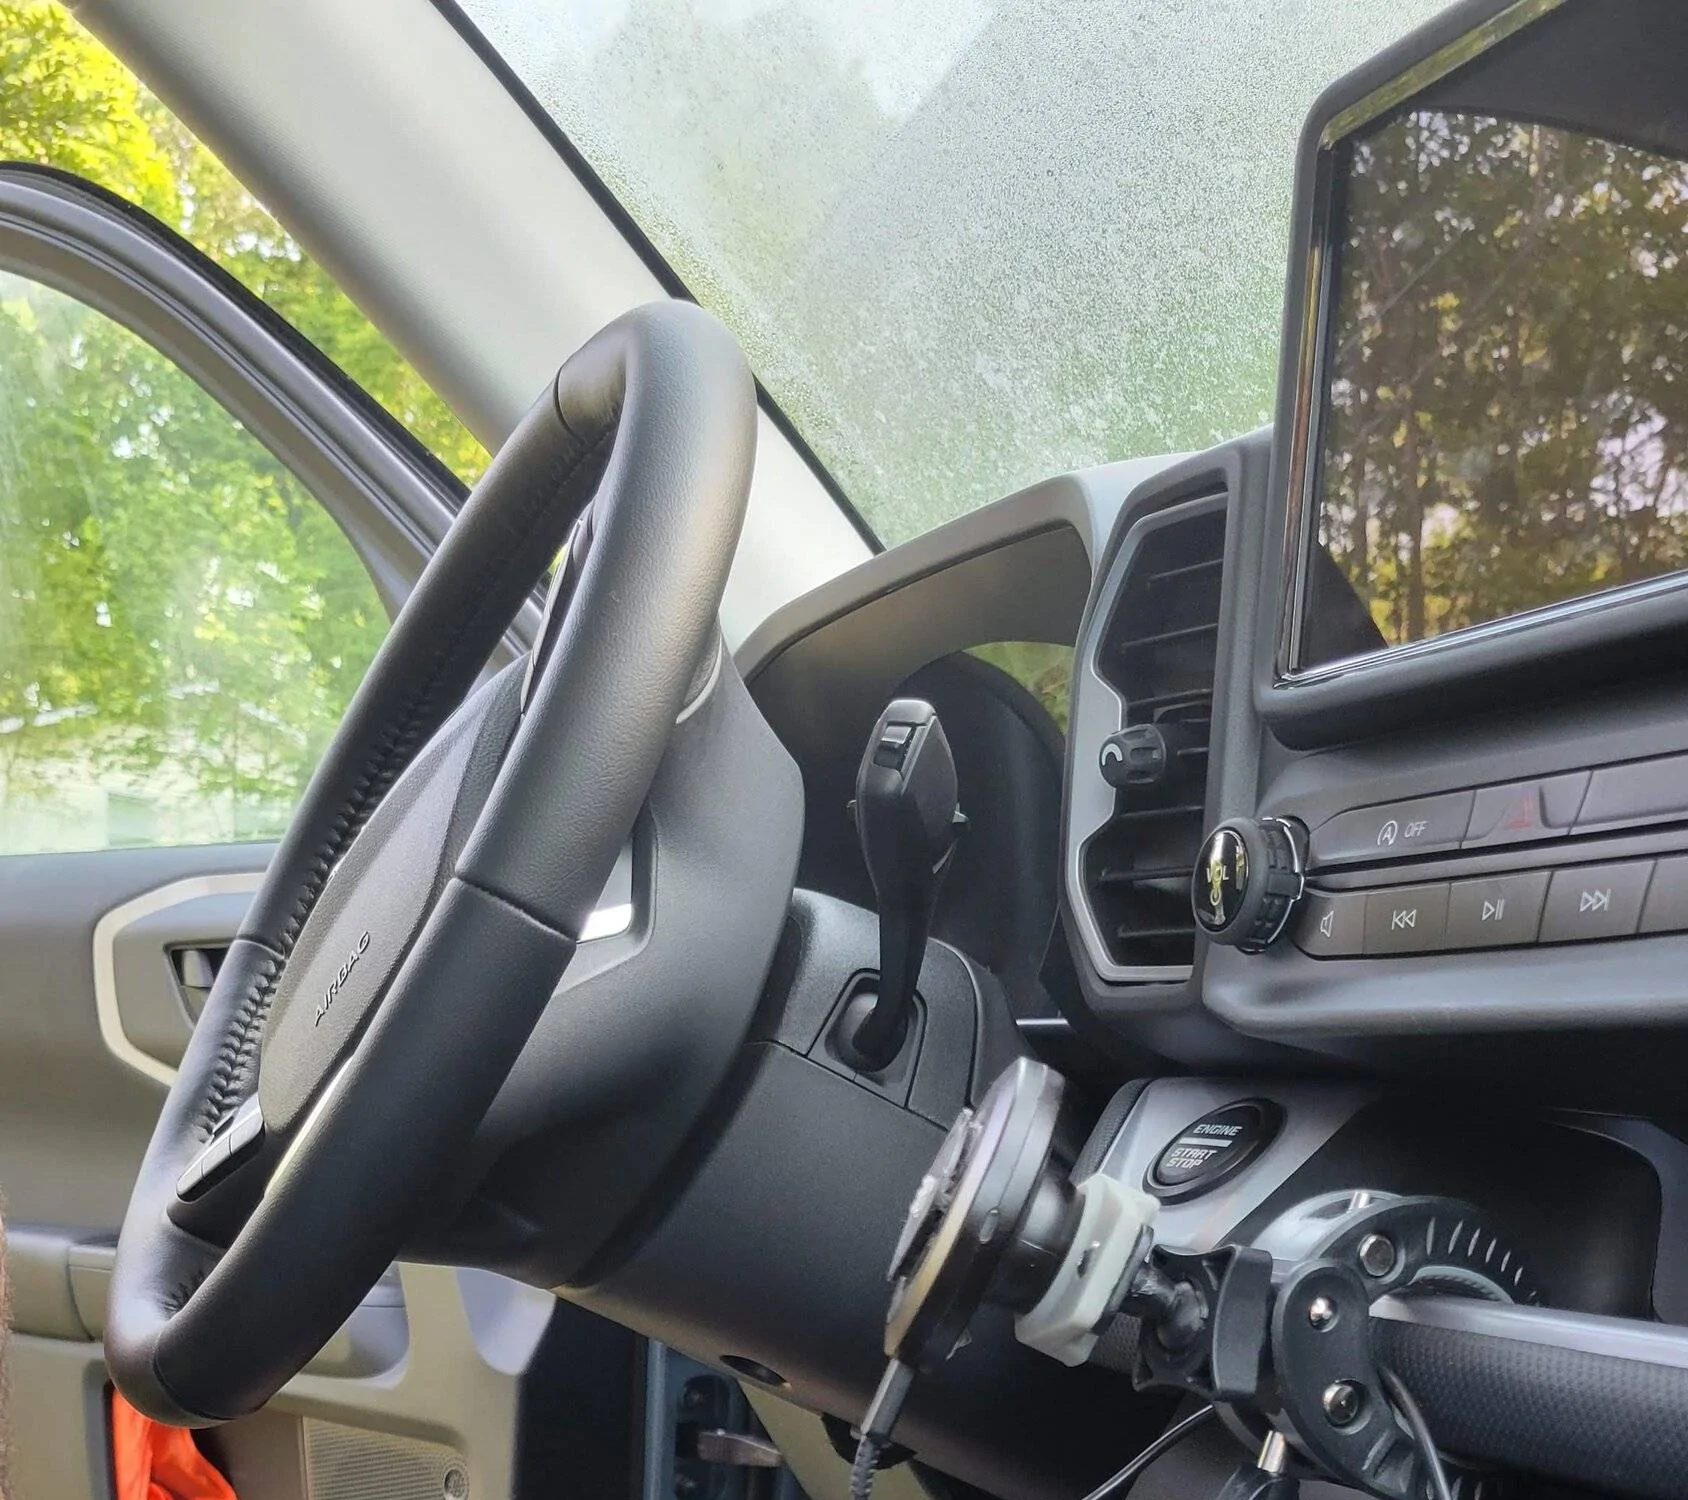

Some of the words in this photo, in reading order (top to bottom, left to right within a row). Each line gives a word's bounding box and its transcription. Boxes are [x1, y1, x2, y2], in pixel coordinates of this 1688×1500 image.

[1404, 820, 1429, 838] OFF
[1206, 865, 1229, 883] VOL
[315, 931, 370, 1027] AIRBAG
[1193, 1123, 1243, 1137] ENGINE
[1171, 1147, 1218, 1160] START
[1166, 1157, 1203, 1169] STOP
